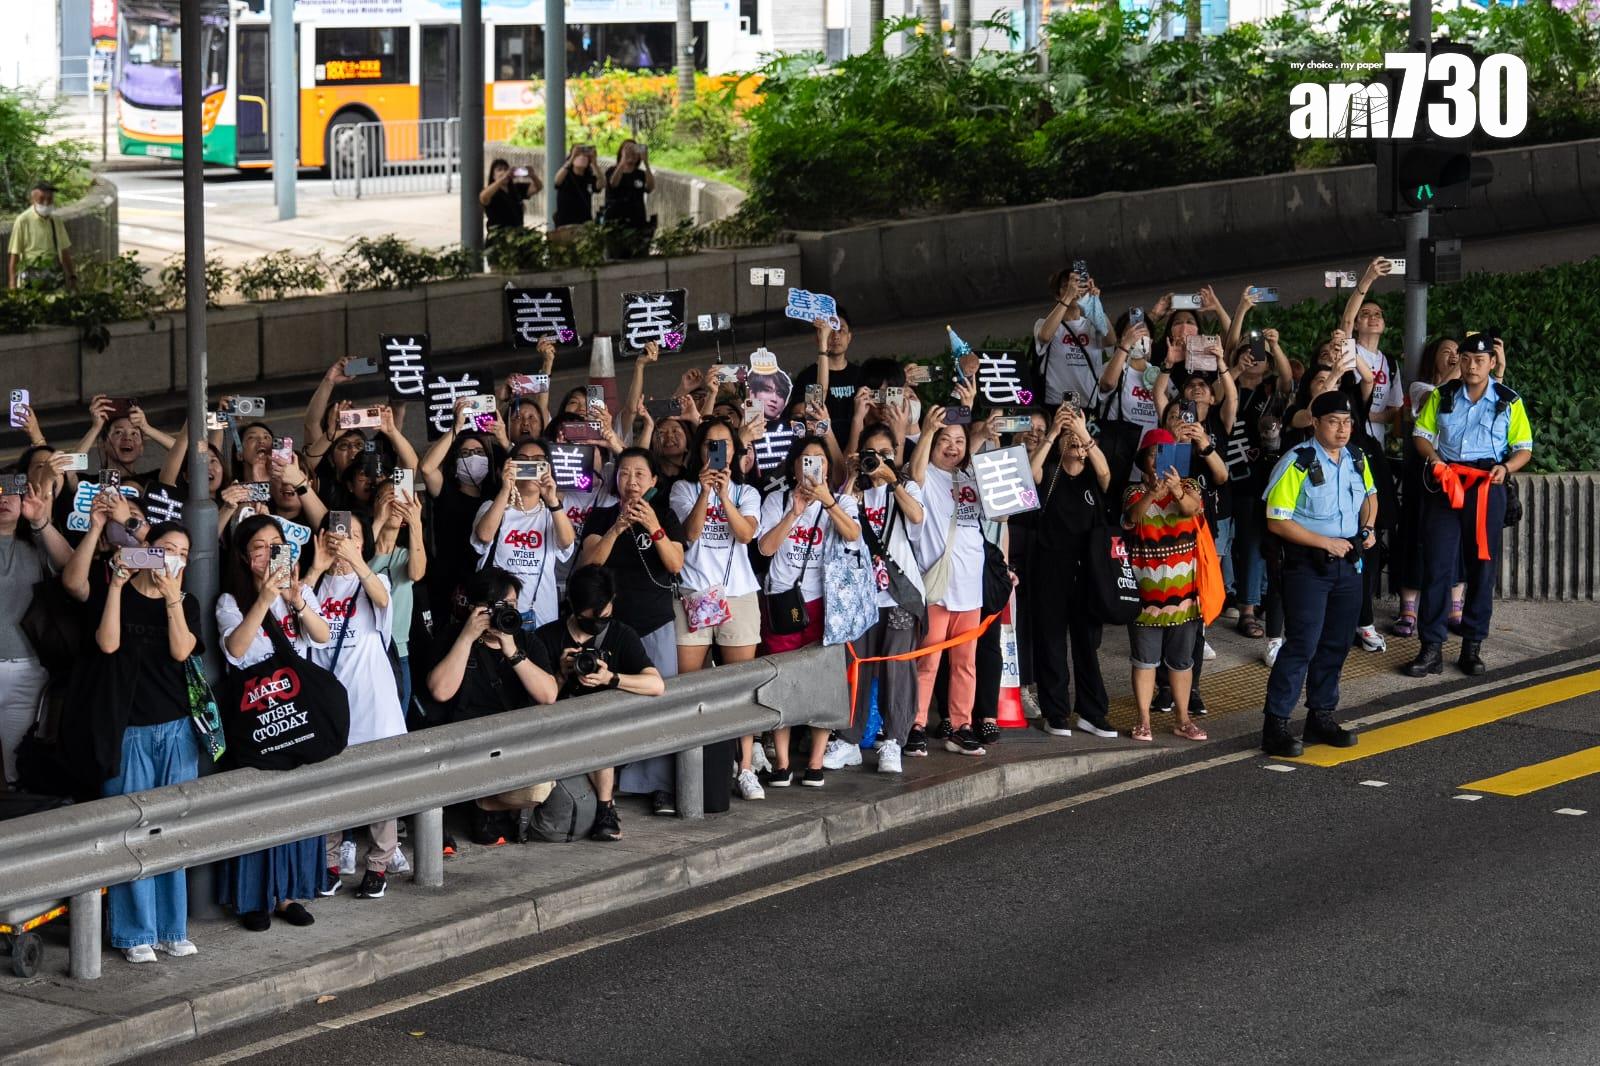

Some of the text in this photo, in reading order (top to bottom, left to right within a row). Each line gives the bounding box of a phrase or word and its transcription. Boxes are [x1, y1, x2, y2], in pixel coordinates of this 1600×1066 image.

[703, 524, 725, 532] WISH
[512, 550, 535, 559] WISH
[247, 678, 292, 704] MAKE
[267, 695, 279, 709] A
[256, 701, 298, 726] WISH
[252, 711, 309, 743] (TO)DAY
